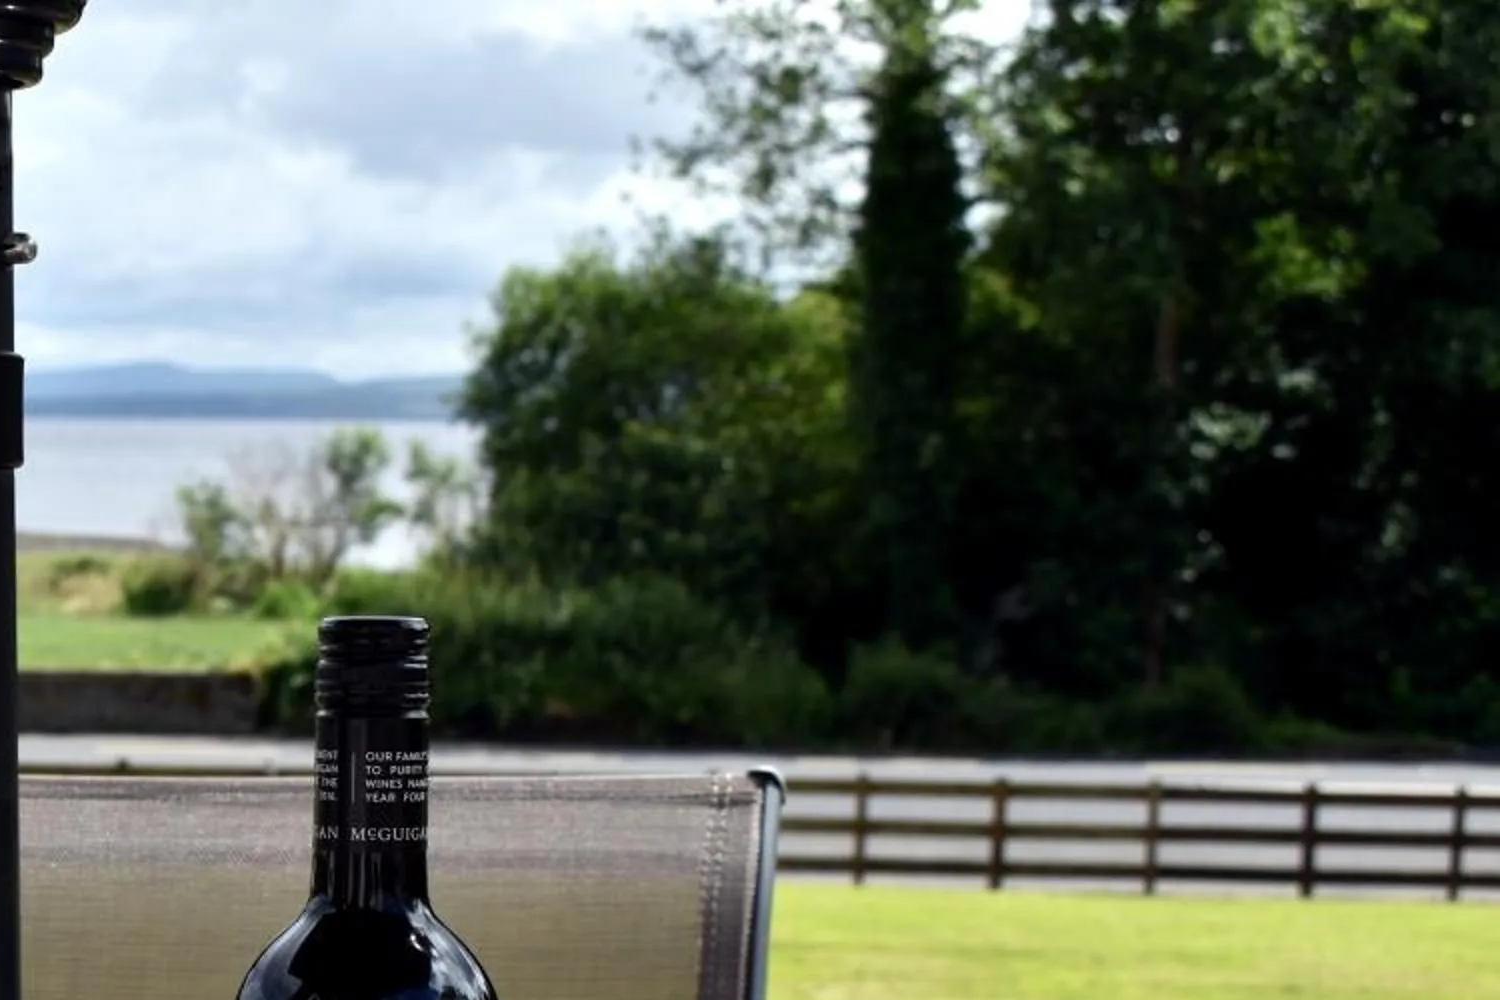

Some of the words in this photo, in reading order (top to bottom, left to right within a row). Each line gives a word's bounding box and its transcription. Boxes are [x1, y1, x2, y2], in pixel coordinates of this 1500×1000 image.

[365, 751, 393, 762] OUR
[365, 765, 382, 775] TO
[365, 779, 403, 789] WINES
[365, 791, 396, 803] YEAR
[350, 825, 427, 841] McGUIGA
